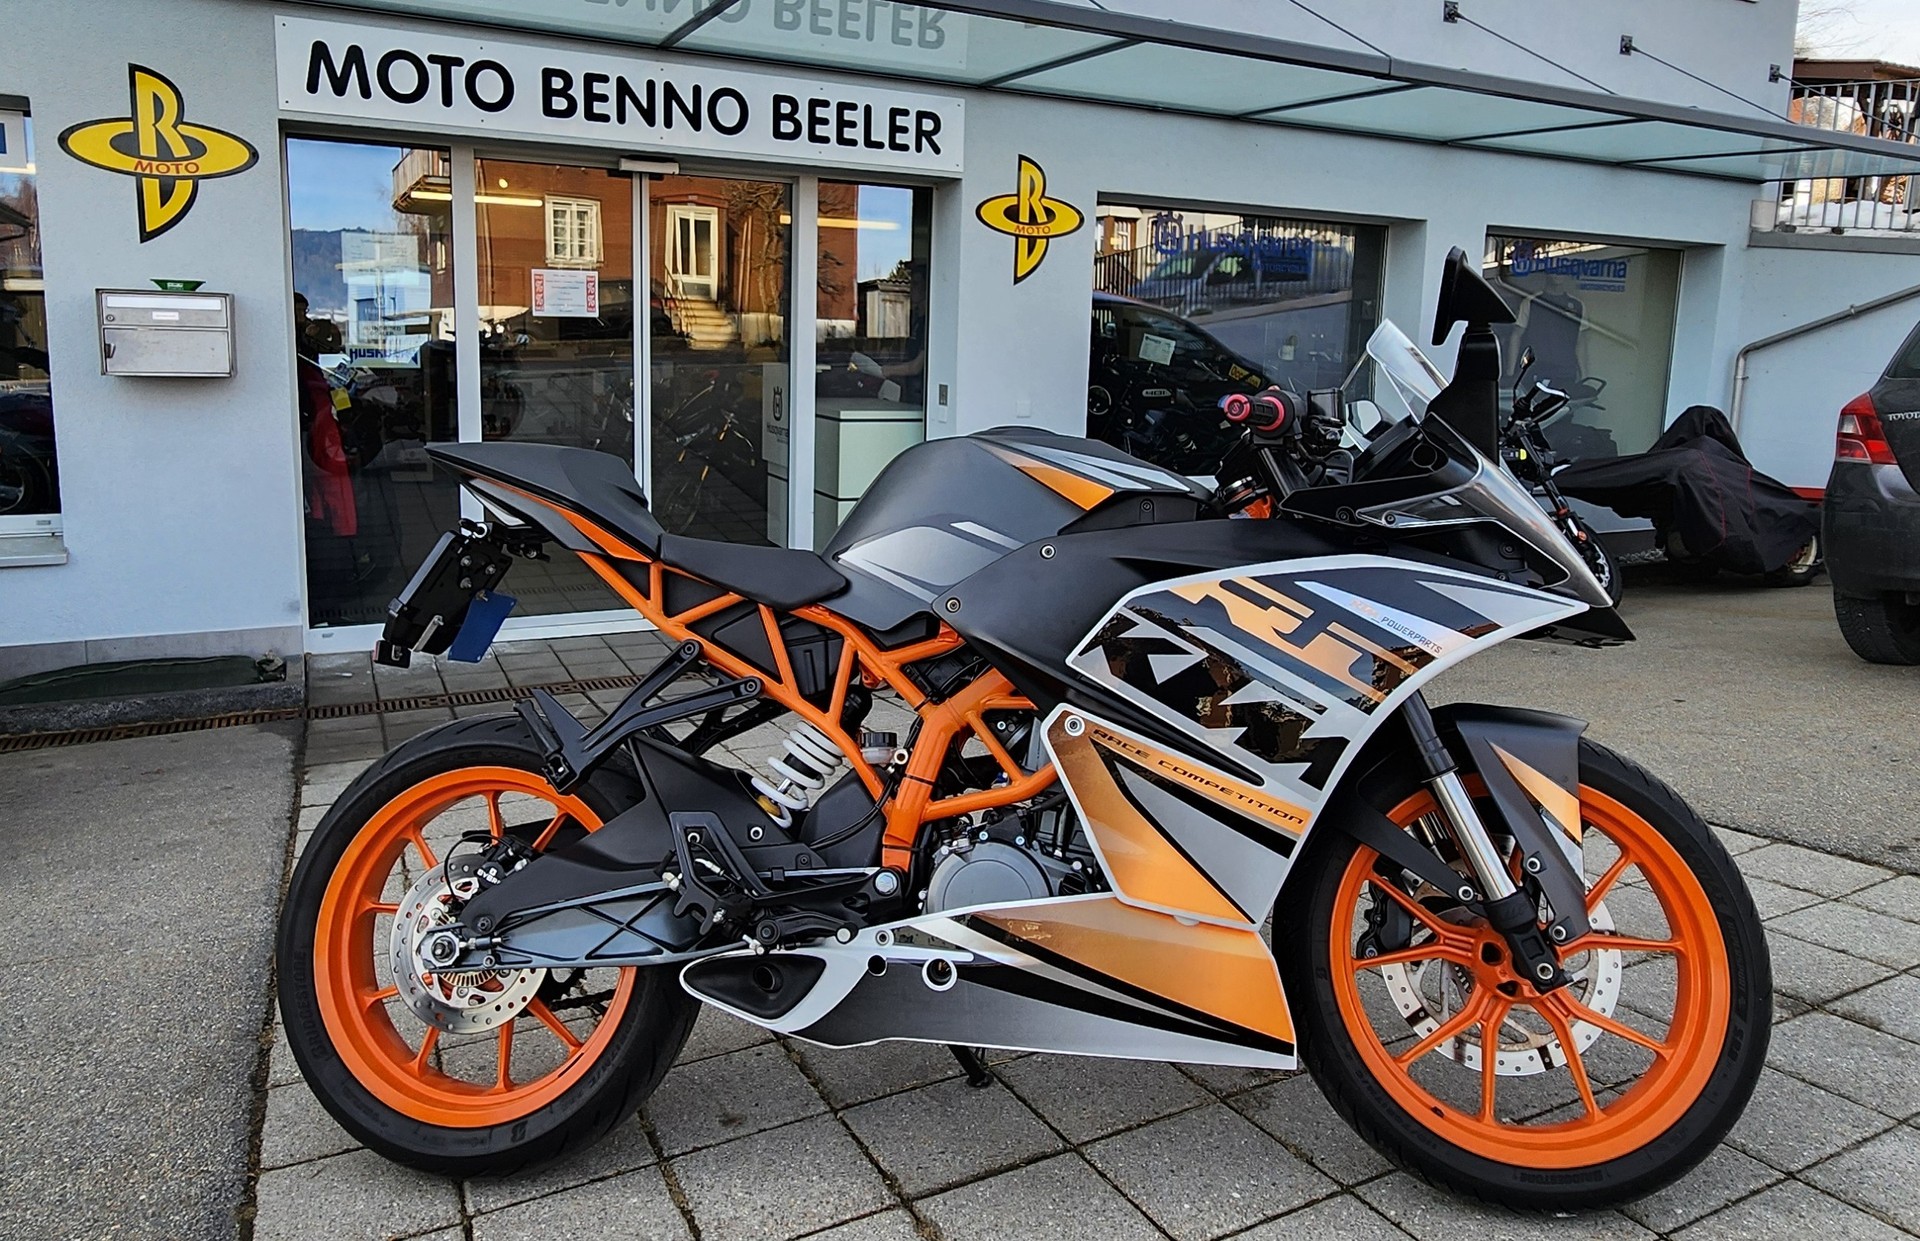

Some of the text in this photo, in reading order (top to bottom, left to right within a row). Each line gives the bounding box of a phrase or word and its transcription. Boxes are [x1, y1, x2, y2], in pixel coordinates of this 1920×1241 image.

[305, 39, 942, 156] MOTO BENNO BEELER
[133, 160, 200, 175] MOTO
[1014, 225, 1052, 235] MOTO
[1887, 411, 1920, 421] TOYOT
[1380, 615, 1444, 655] POWERPARTS
[1093, 728, 1305, 825] RACE COMPETITION
